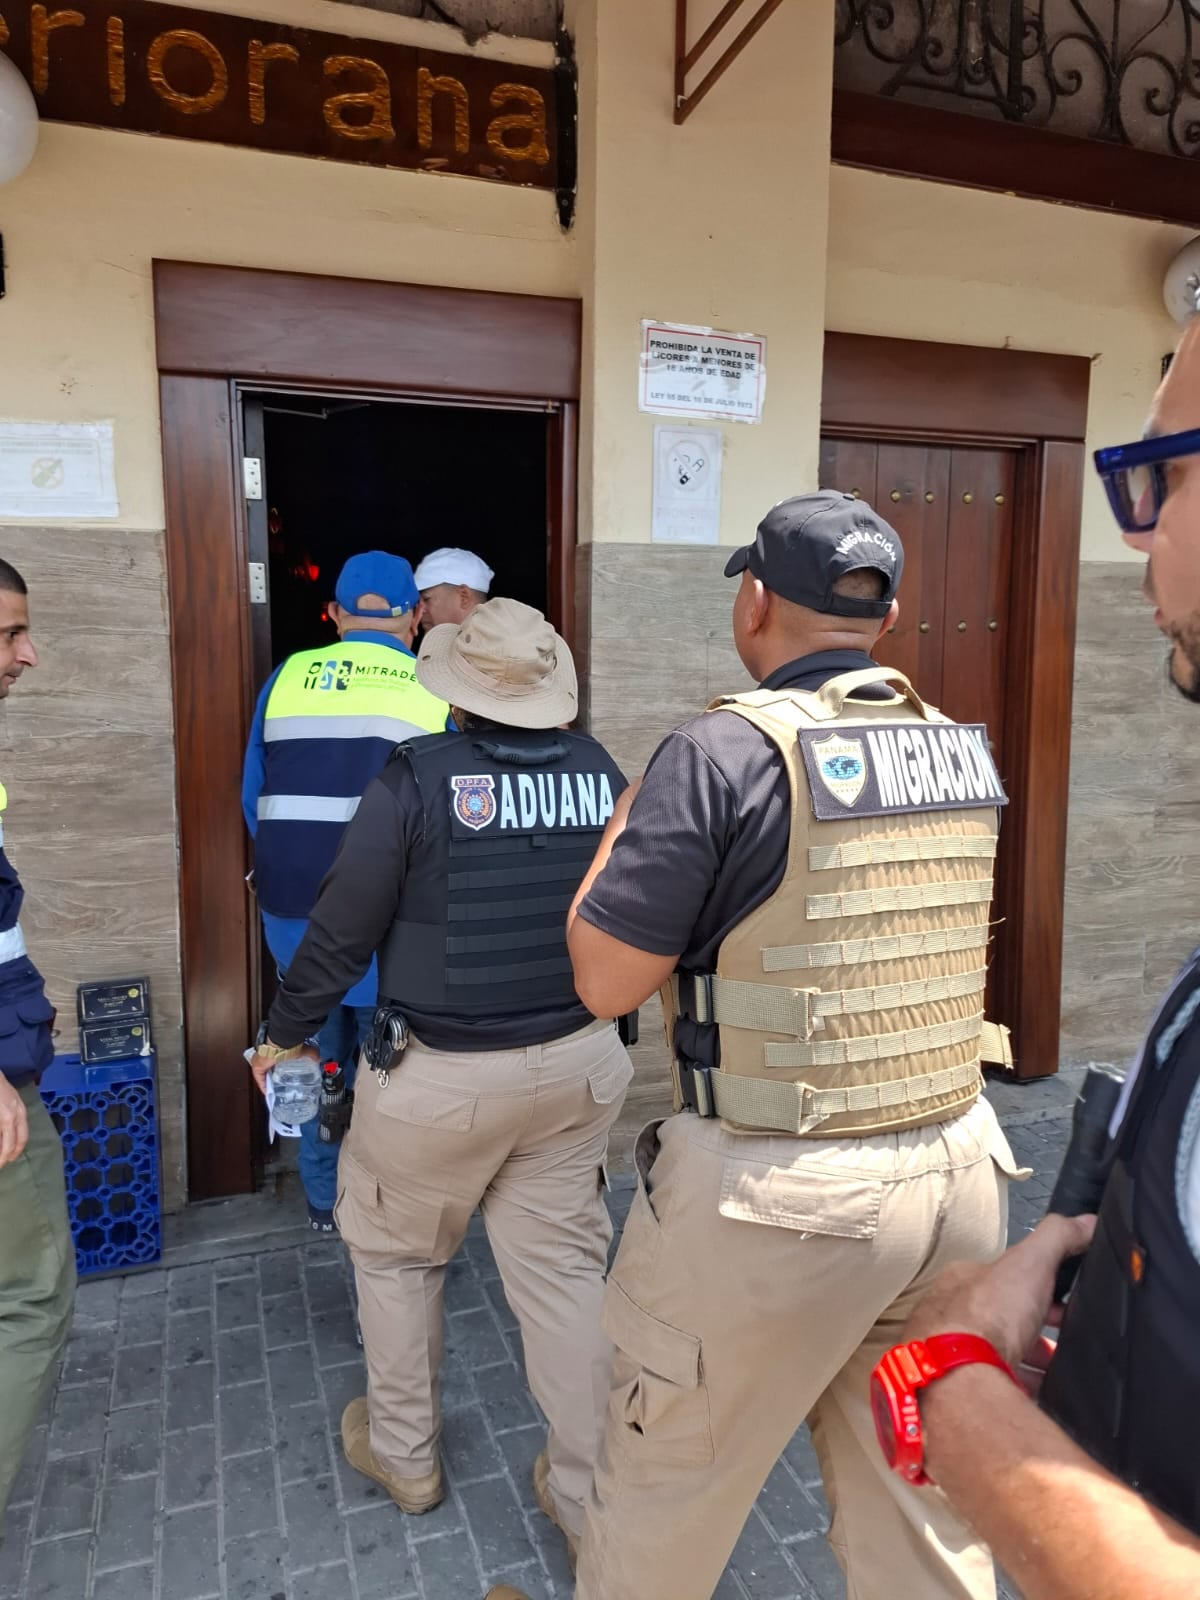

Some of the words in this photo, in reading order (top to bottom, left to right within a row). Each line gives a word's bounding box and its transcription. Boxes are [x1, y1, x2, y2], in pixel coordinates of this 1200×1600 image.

[0, 5, 550, 164] riorana
[650, 340, 698, 352] PROHIBIDA
[701, 345, 713, 354] LA
[715, 347, 742, 359] VENTA
[744, 352, 757, 360] DE
[701, 356, 742, 369] MENORES
[744, 362, 756, 371] DE
[720, 369, 742, 380] EDAD
[650, 391, 665, 400] LEY
[866, 728, 1003, 808] MIGRACION
[500, 773, 615, 829] ADUANA
